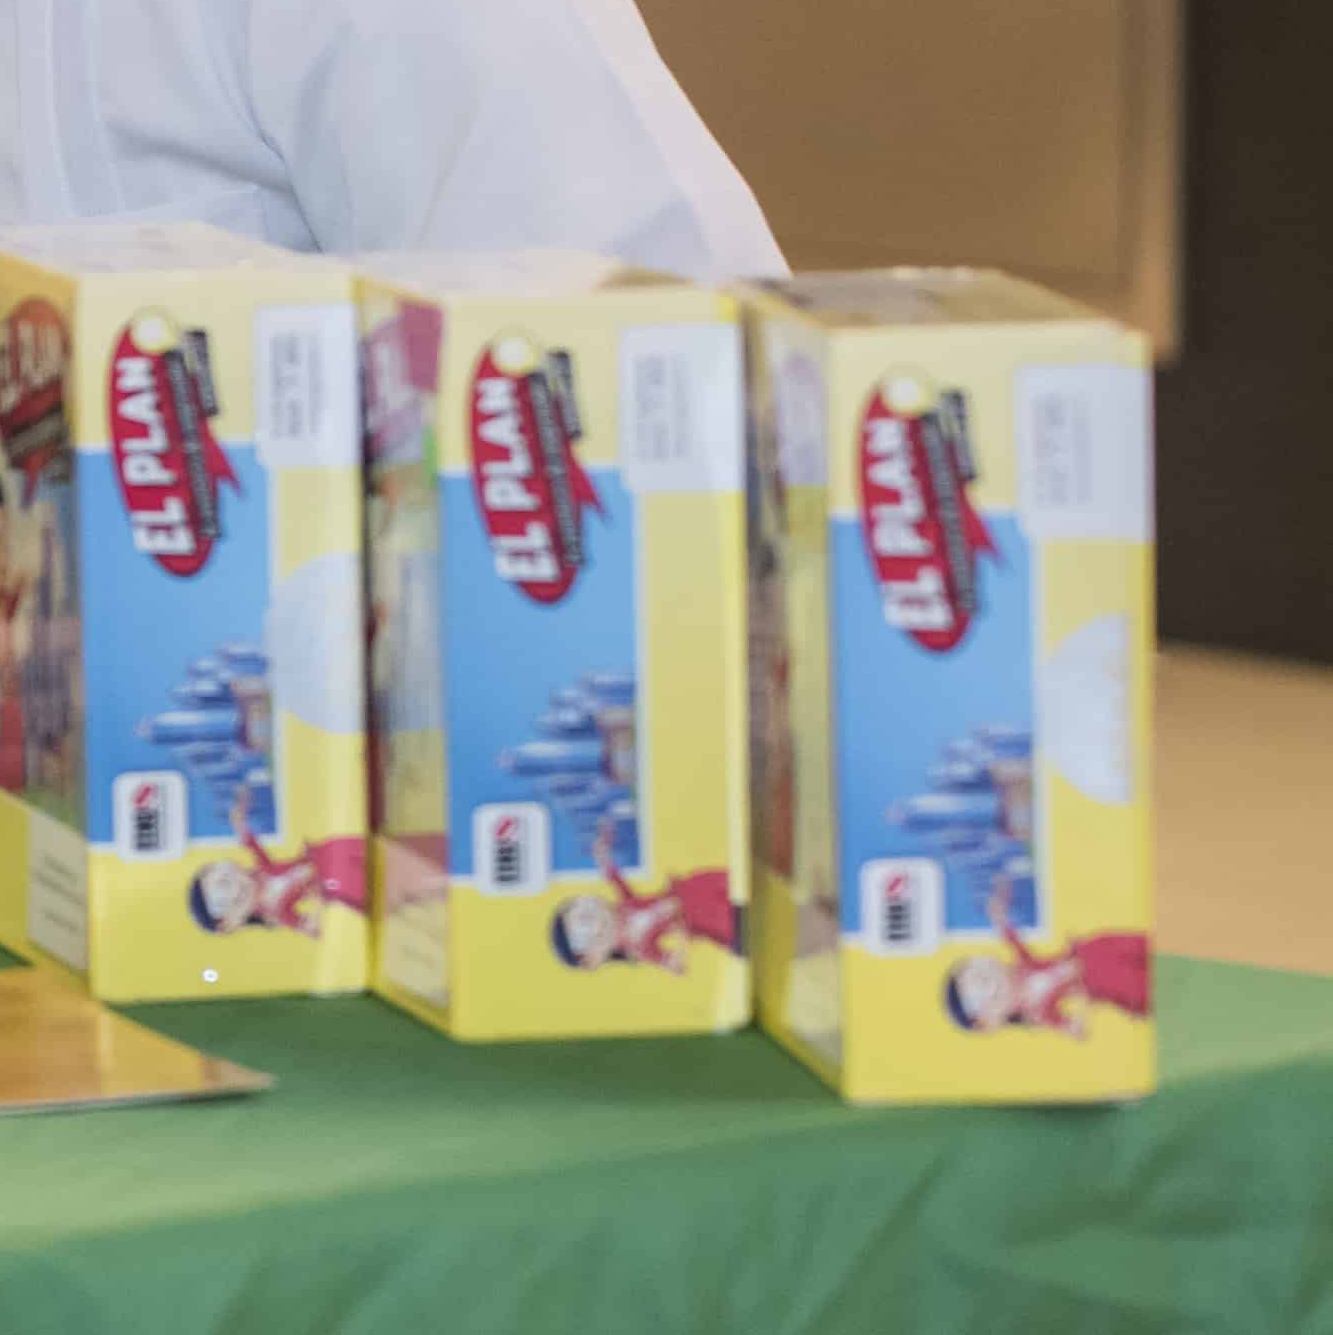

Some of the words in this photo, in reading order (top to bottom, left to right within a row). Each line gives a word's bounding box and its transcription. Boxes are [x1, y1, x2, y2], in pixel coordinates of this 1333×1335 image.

[116, 356, 178, 486] PLAN
[477, 378, 540, 512] PLAN
[130, 496, 196, 555] EL
[865, 418, 934, 557] PLAN
[492, 520, 561, 583] EL
[882, 564, 955, 631] EL
